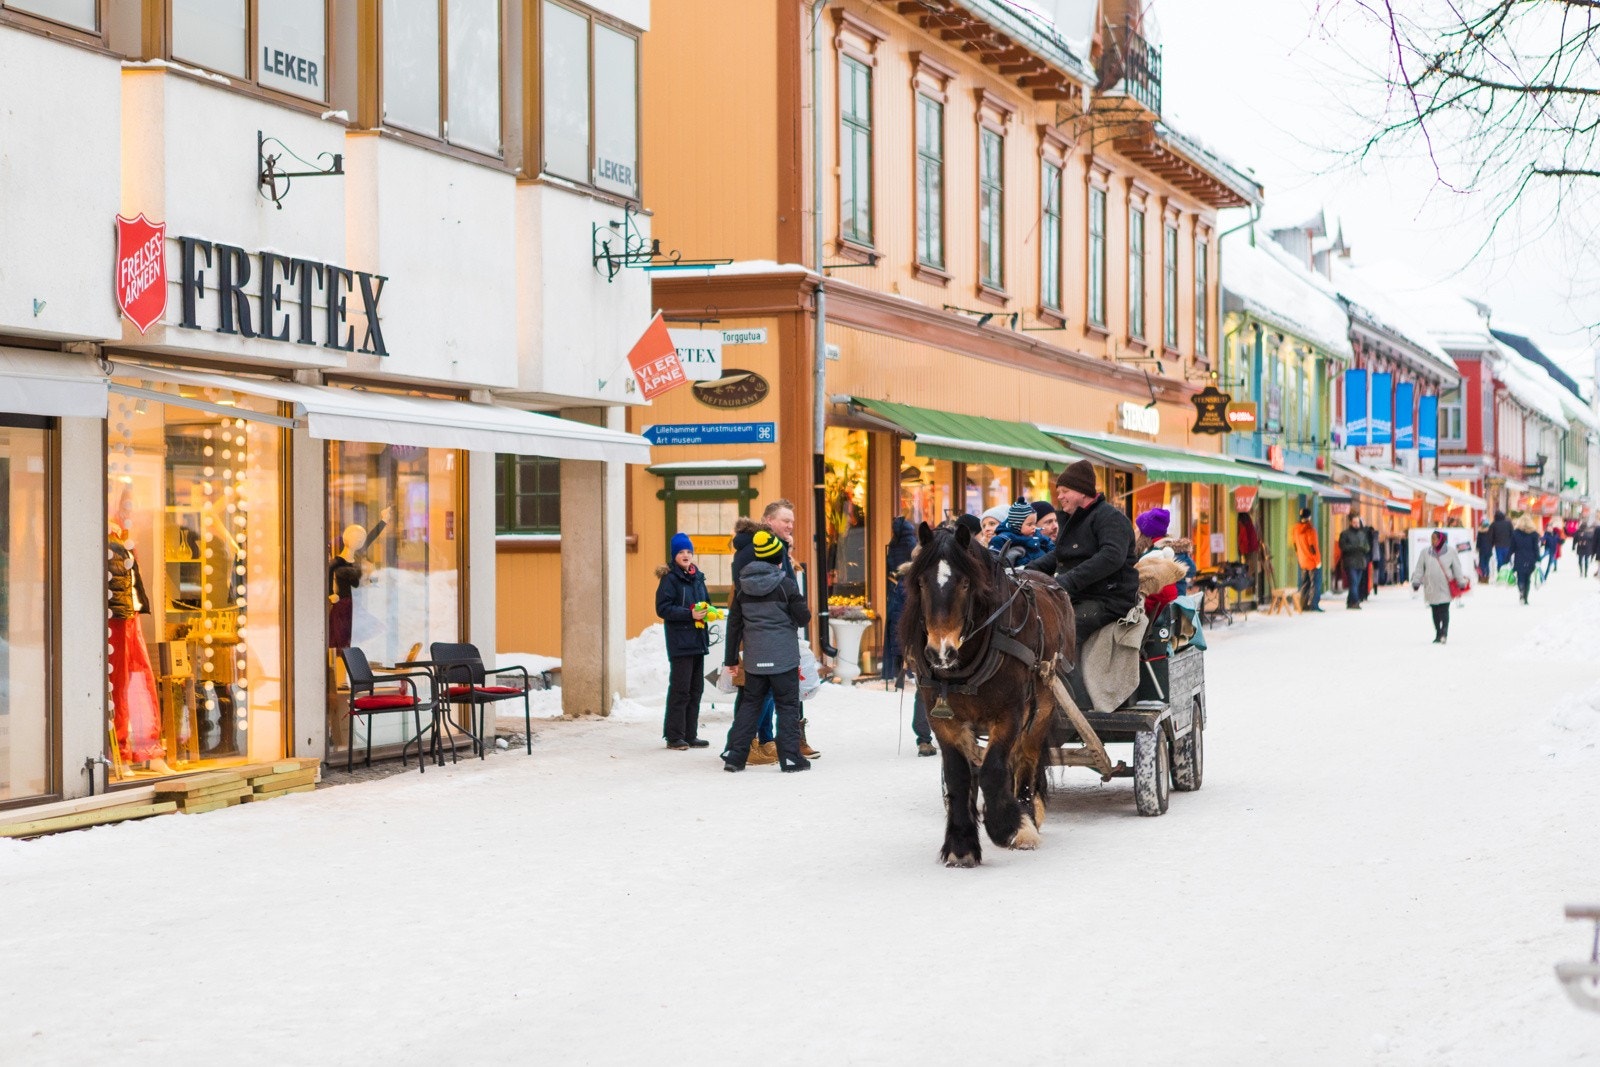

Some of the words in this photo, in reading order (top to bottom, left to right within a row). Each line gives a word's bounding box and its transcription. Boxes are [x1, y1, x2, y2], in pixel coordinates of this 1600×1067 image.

[264, 46, 318, 86] LEKER
[598, 157, 631, 186] LEKER
[124, 257, 161, 307] ARMEEN
[179, 236, 389, 357] FRETEX
[723, 332, 761, 343] Torggutua
[635, 366, 653, 379] VI
[654, 355, 677, 371] ER
[702, 394, 759, 406] RESTAURANT
[655, 426, 698, 434] Lillehammer
